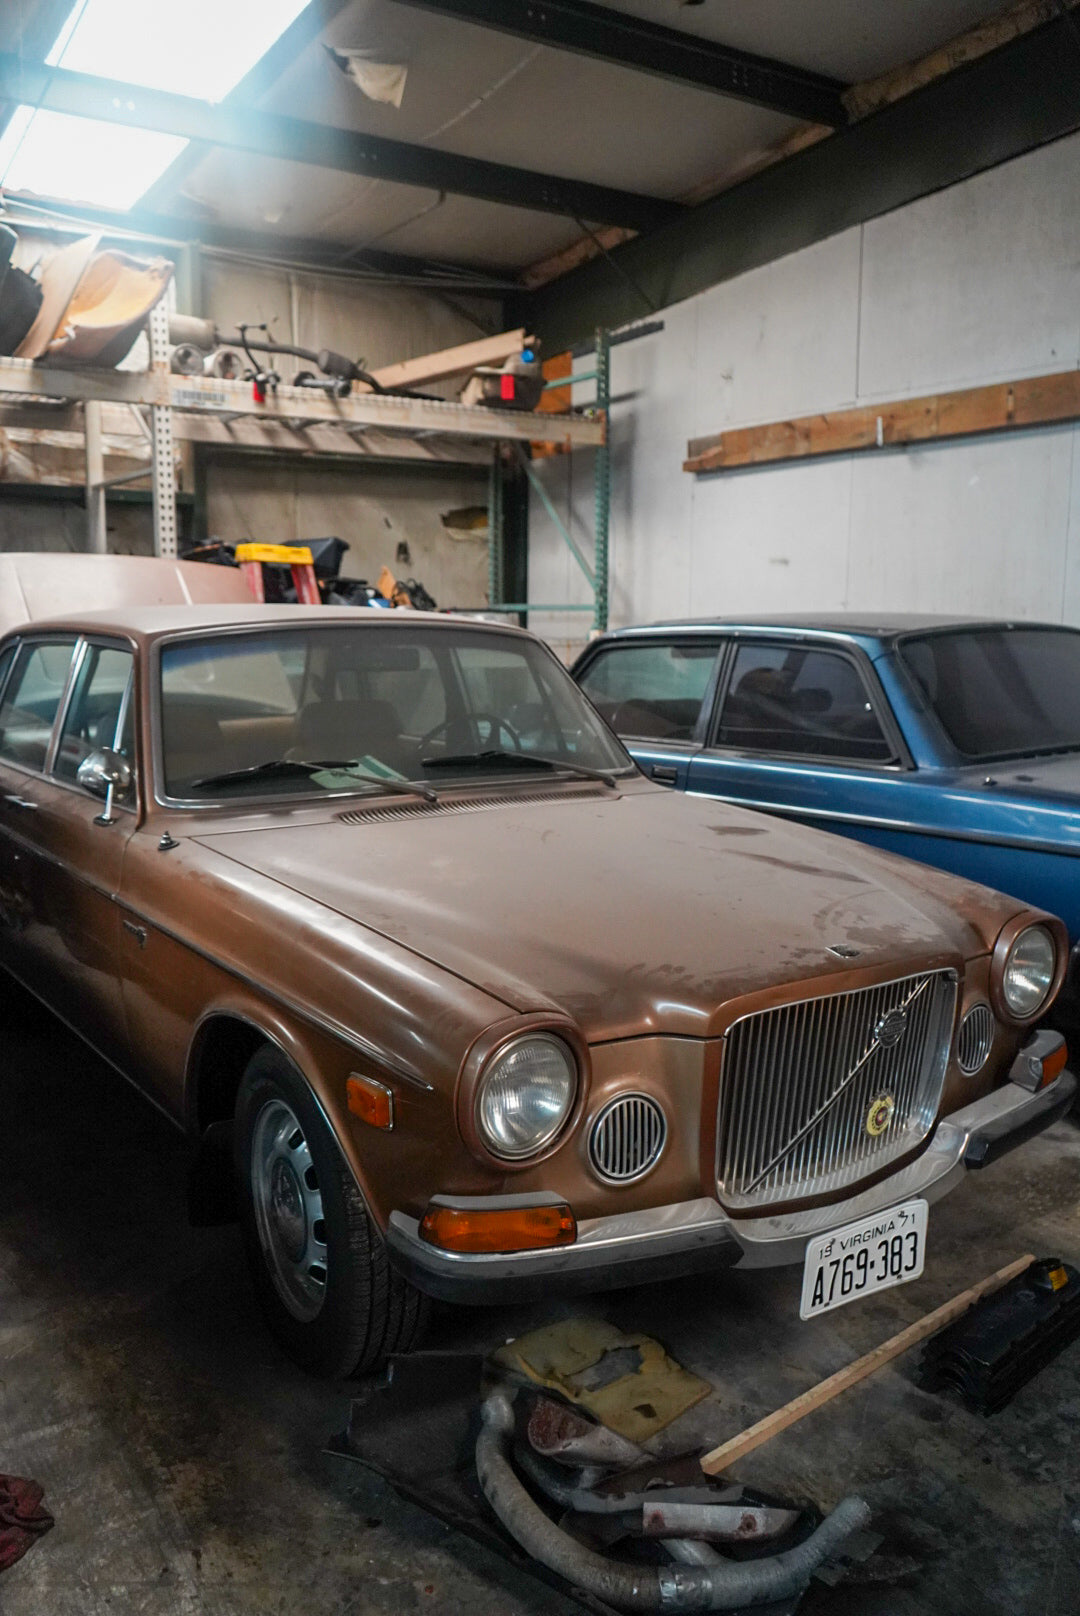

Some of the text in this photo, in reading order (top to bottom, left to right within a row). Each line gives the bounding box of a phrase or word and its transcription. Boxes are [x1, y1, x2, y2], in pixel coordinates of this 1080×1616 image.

[819, 1213, 915, 1260] 19 VIRGINIA 71
